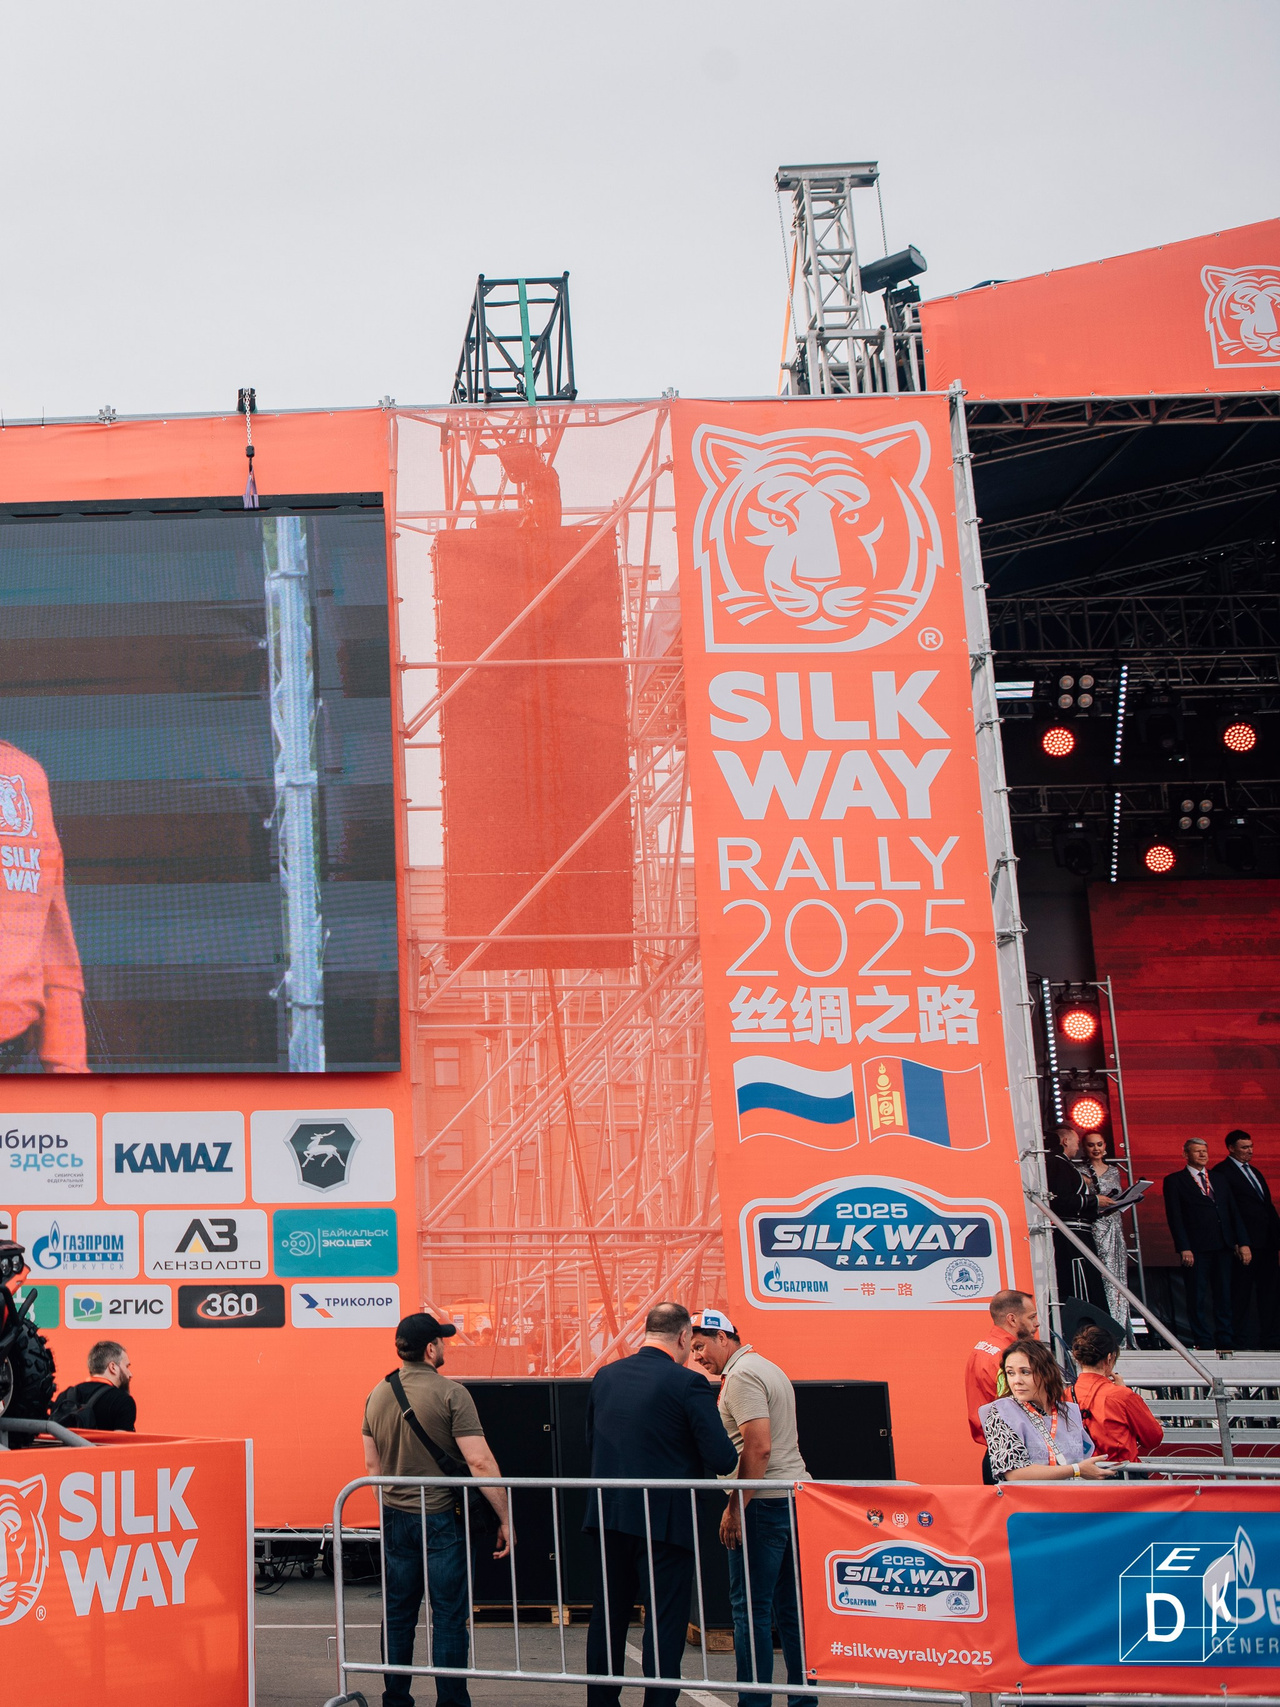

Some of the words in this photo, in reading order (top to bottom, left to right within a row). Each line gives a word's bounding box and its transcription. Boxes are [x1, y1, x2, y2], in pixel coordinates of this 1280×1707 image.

[709, 670, 951, 742] SILK
[712, 749, 952, 820] WAY
[2, 845, 41, 871] SILK
[717, 836, 960, 891] RALLY
[2, 868, 41, 894] WAY
[723, 899, 975, 978] 2025
[729, 985, 980, 1046] 丝绸之路
[9, 1153, 84, 1171] здесь
[114, 1142, 233, 1173] KAMAZ
[836, 1203, 908, 1219] 2025
[63, 1234, 123, 1250] ГАЗПРОМ
[322, 1228, 389, 1238] БАЙКАЛЬСК
[771, 1224, 878, 1251] SILK
[883, 1224, 979, 1251] WAY
[322, 1239, 372, 1248] ЭКО.ЦЕХ
[64, 1253, 123, 1261] ДОБЫЧА
[153, 1260, 261, 1270] ЛЕНЗОЛОТО
[836, 1254, 918, 1266] RALLY
[783, 1280, 829, 1293] GAZPROM
[843, 1283, 913, 1297] 一带一路
[109, 1299, 164, 1314] 2ГИС
[206, 1293, 258, 1316] 360
[324, 1297, 393, 1307] ТРИКОЛОР
[58, 1466, 199, 1542] SILK
[881, 1554, 926, 1567] 2025
[59, 1538, 199, 1617] WAY
[843, 1565, 907, 1584] SILK
[909, 1569, 968, 1587] WAY
[881, 1585, 931, 1594] RALLY
[849, 1597, 877, 1607] GAZPROM
[830, 1641, 993, 1666] #silkwayrally2025
